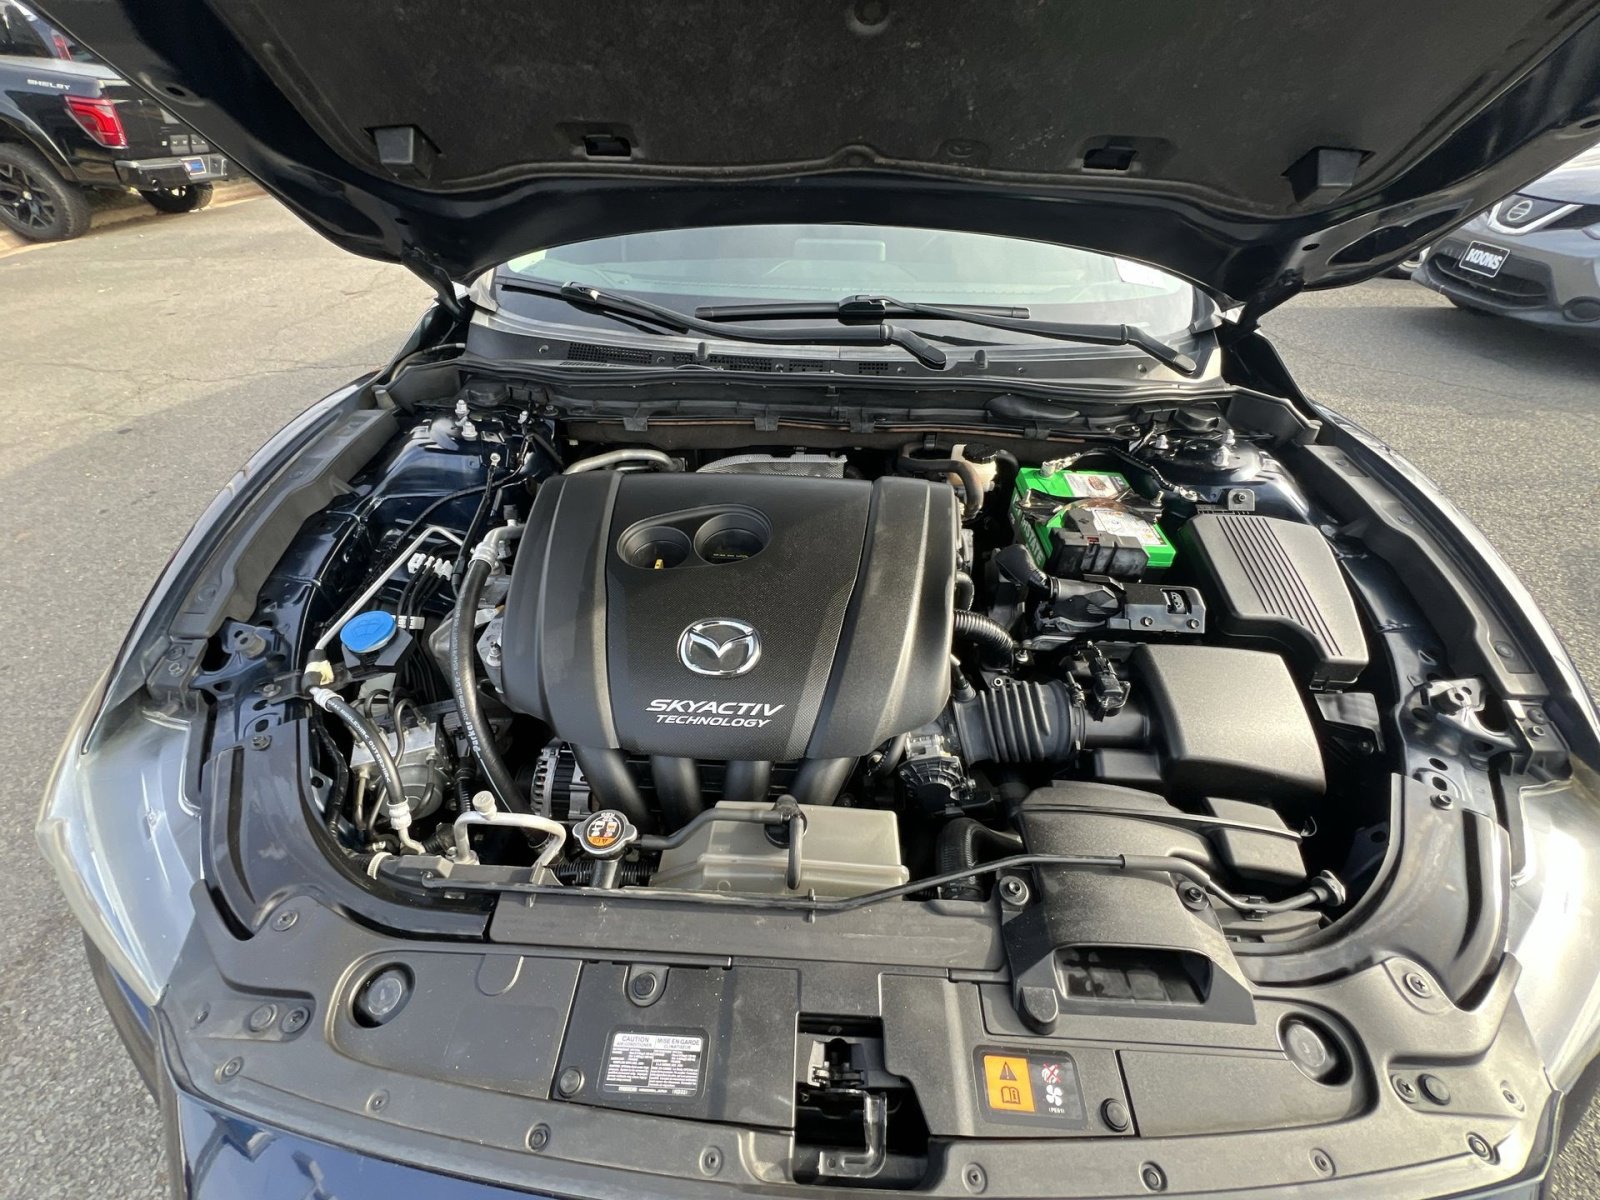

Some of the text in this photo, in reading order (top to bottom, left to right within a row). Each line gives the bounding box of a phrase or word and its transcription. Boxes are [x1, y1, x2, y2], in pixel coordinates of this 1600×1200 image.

[27, 79, 71, 91] SHELBY
[1465, 248, 1503, 270] KOONS
[645, 699, 785, 716] SKYACTIV
[656, 714, 772, 728] TECHNOLOGY
[621, 1035, 650, 1043] CAUTION
